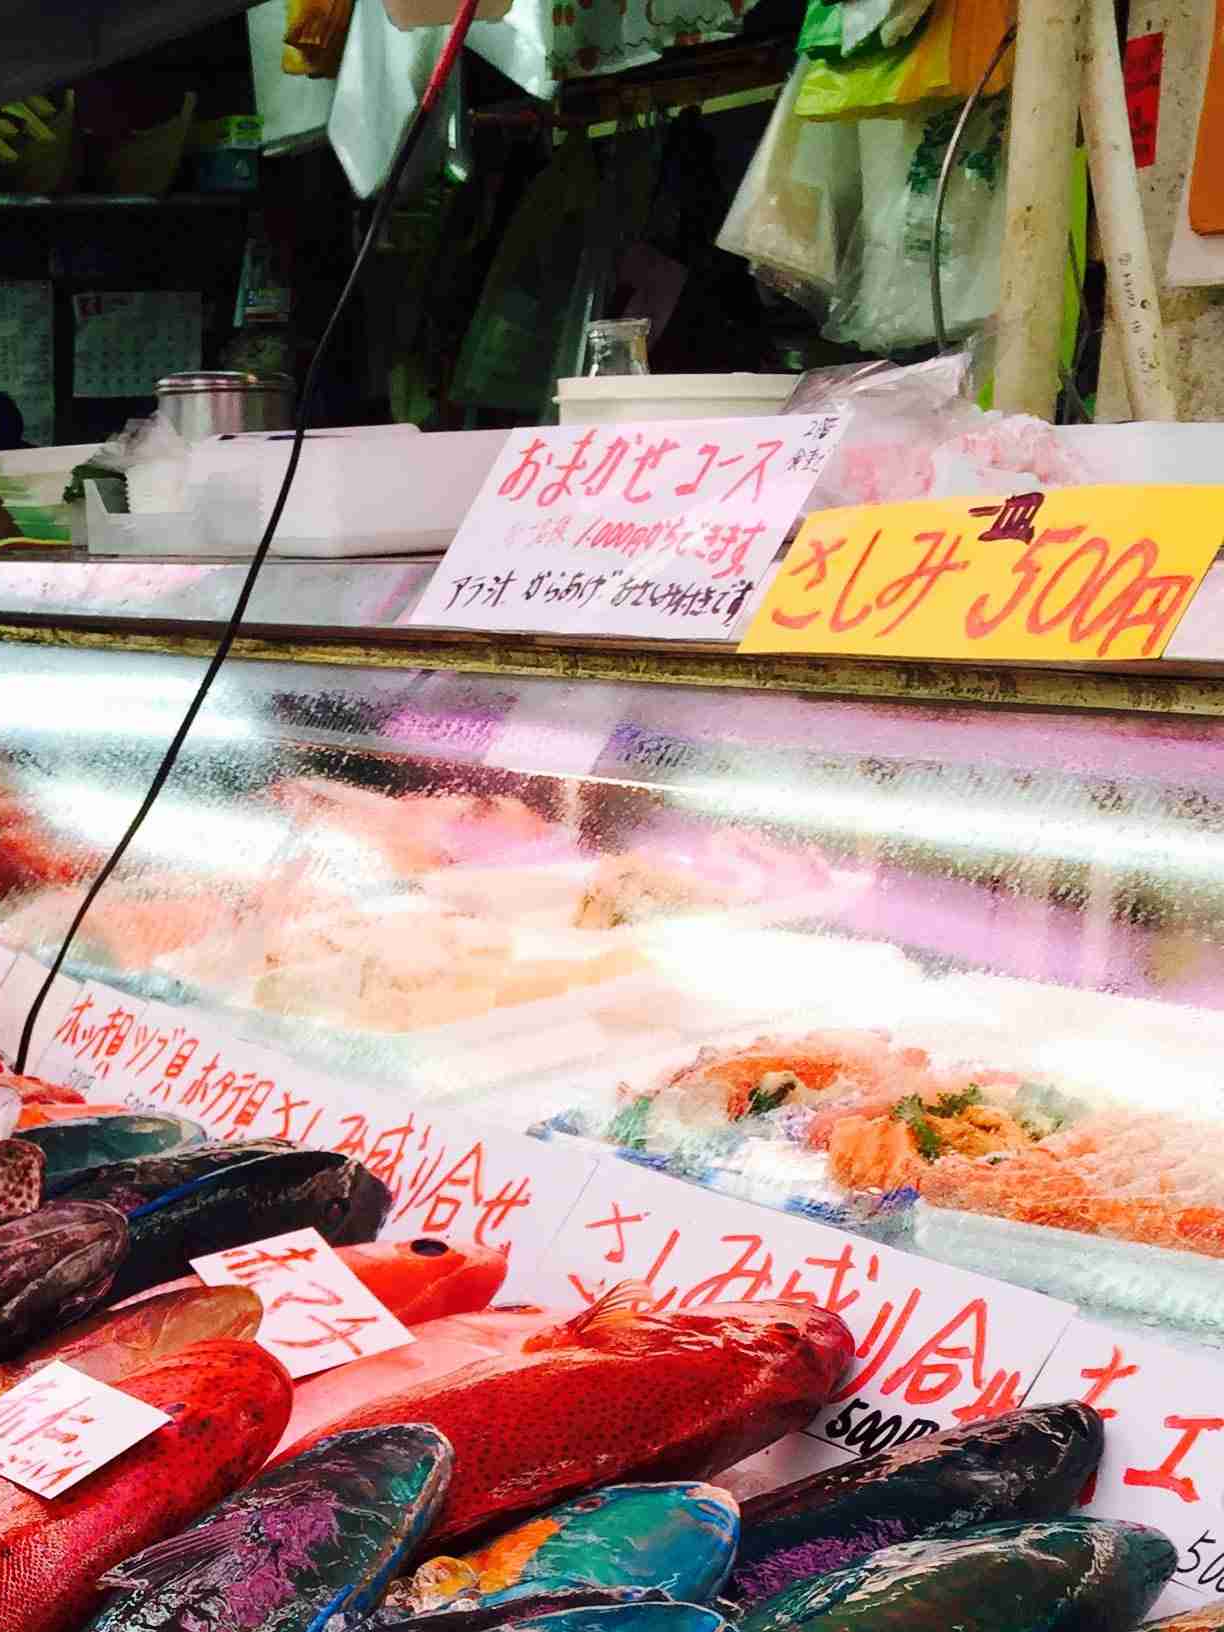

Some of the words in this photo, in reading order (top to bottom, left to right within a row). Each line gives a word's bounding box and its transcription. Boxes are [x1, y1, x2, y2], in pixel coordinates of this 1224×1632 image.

[772, 529, 970, 640] さしみ
[965, 526, 1195, 657] 500円
